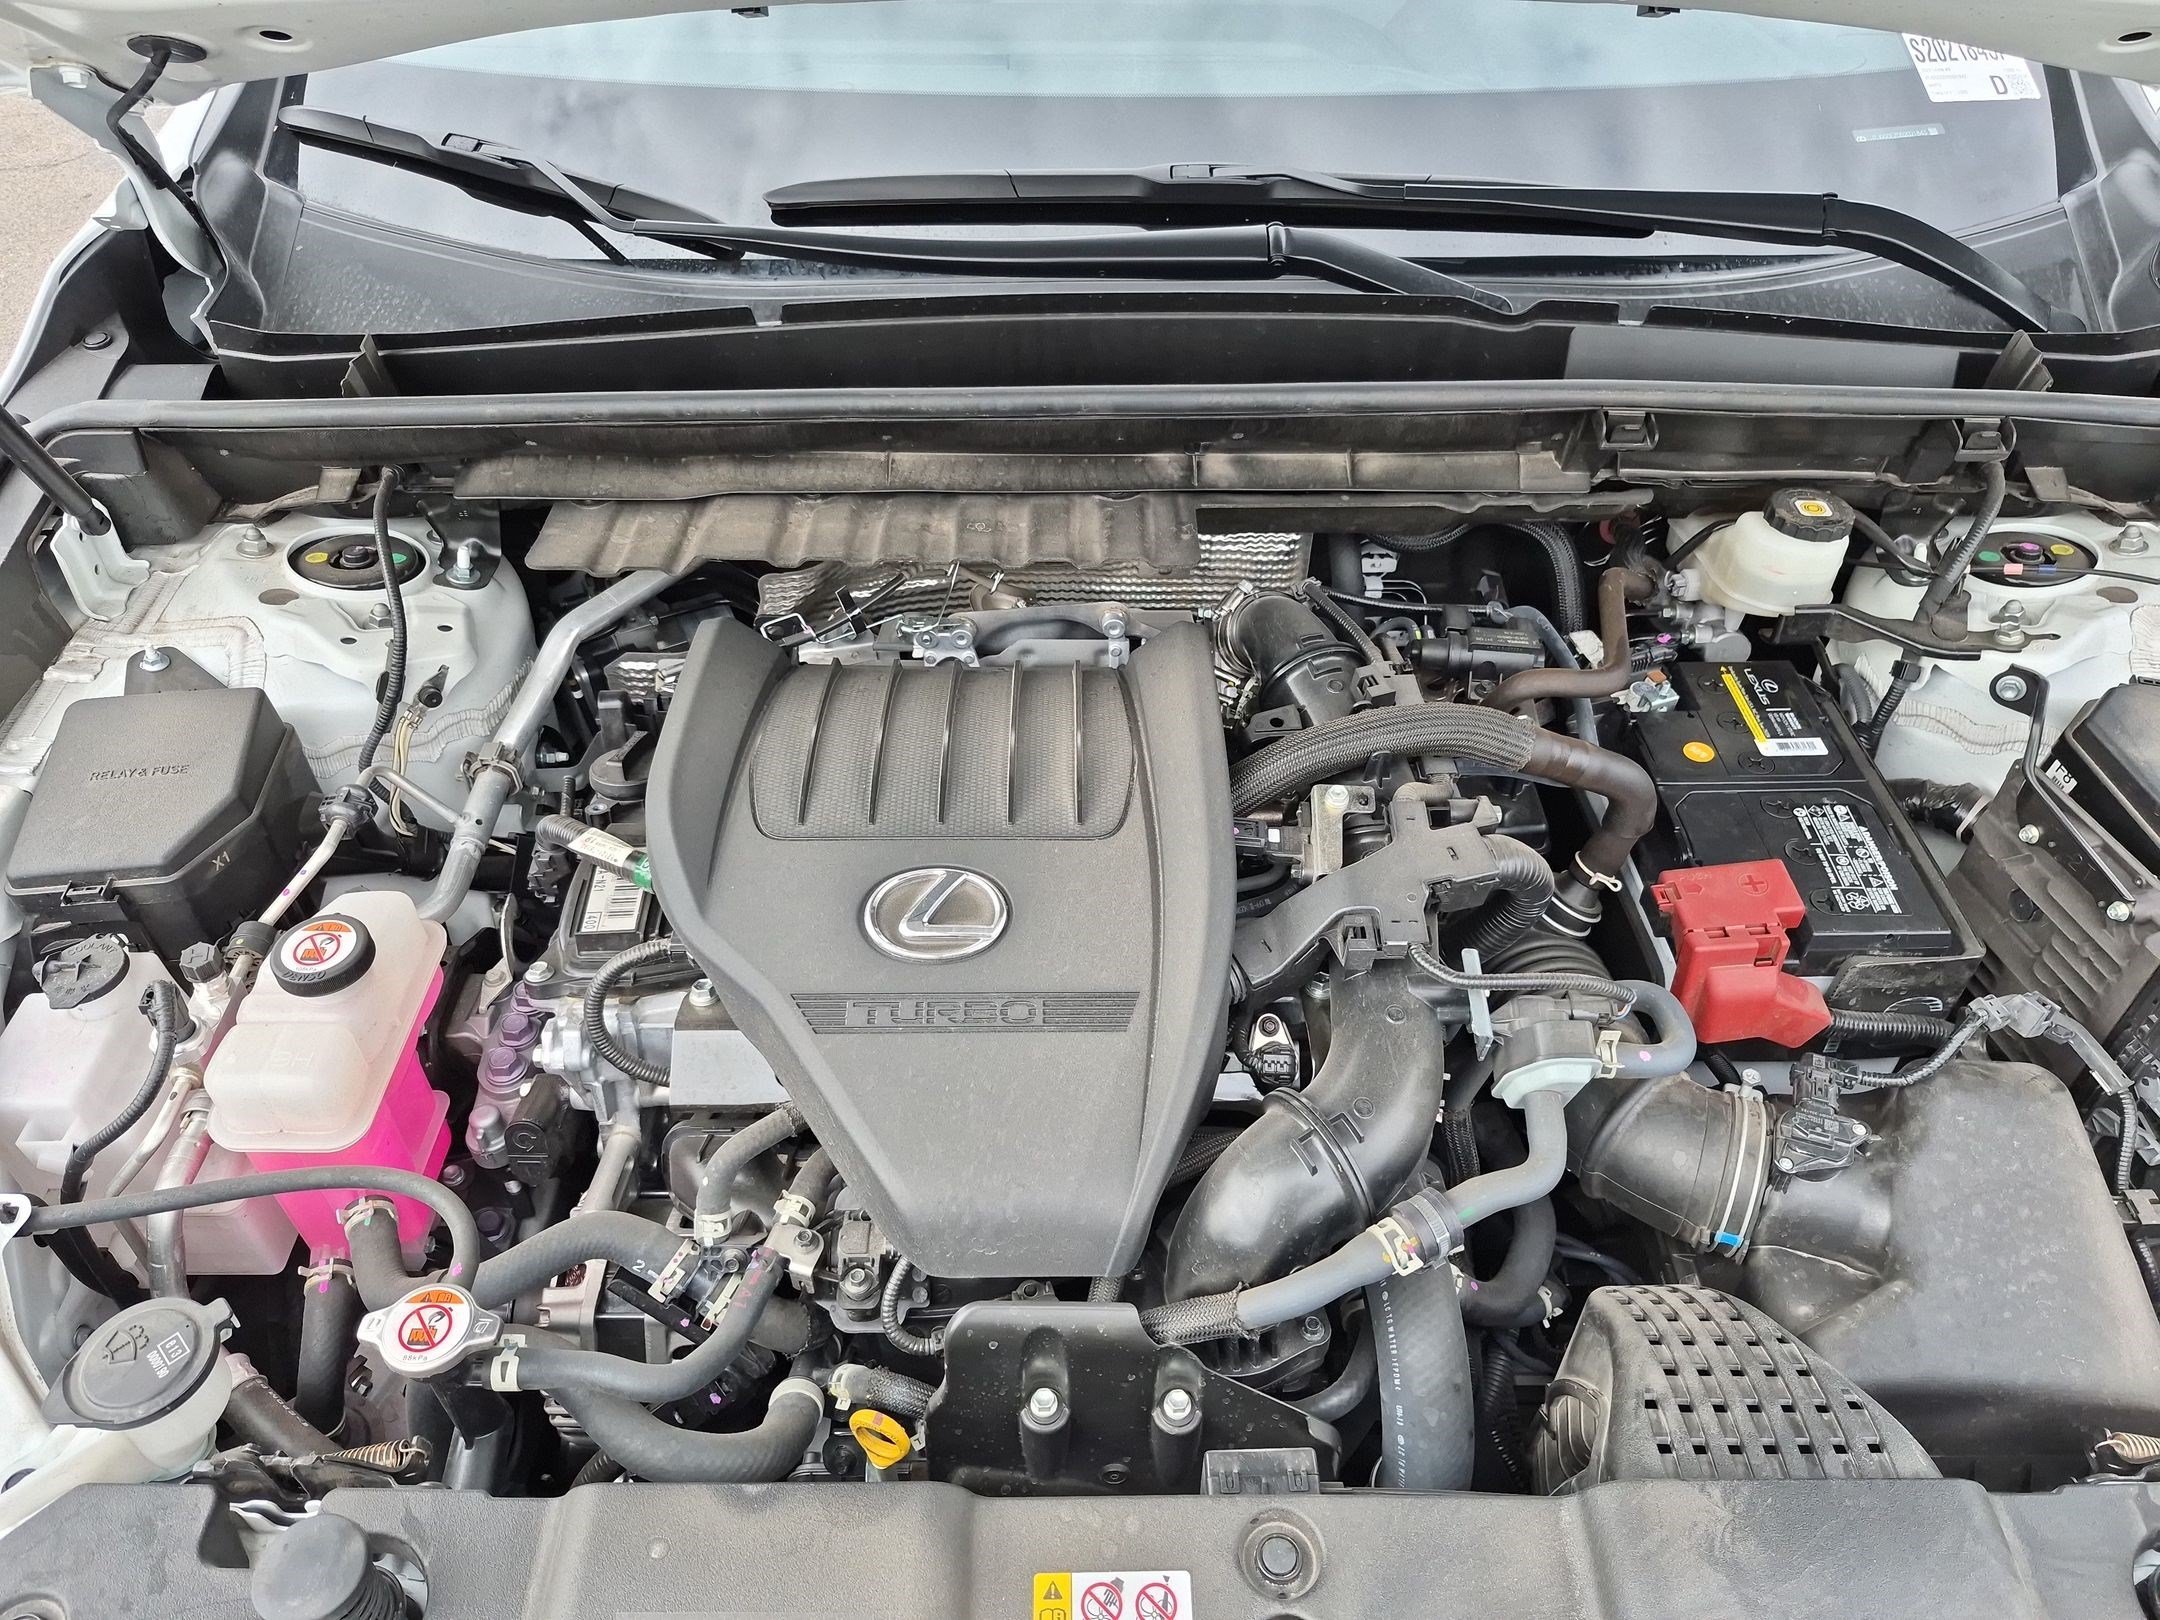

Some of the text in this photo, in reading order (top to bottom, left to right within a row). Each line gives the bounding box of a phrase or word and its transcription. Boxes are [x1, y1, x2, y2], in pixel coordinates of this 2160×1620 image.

[1989, 75, 2008, 95] D
[1744, 668, 1770, 706] LEXUS
[151, 764, 191, 777] FUSE
[211, 851, 231, 871] X1
[68, 943, 118, 956] COOLANT
[282, 970, 327, 982] DENSO
[852, 1000, 1038, 1024] TURBO
[165, 1339, 183, 1358] e13
[1387, 1325, 1399, 1355] WATER
